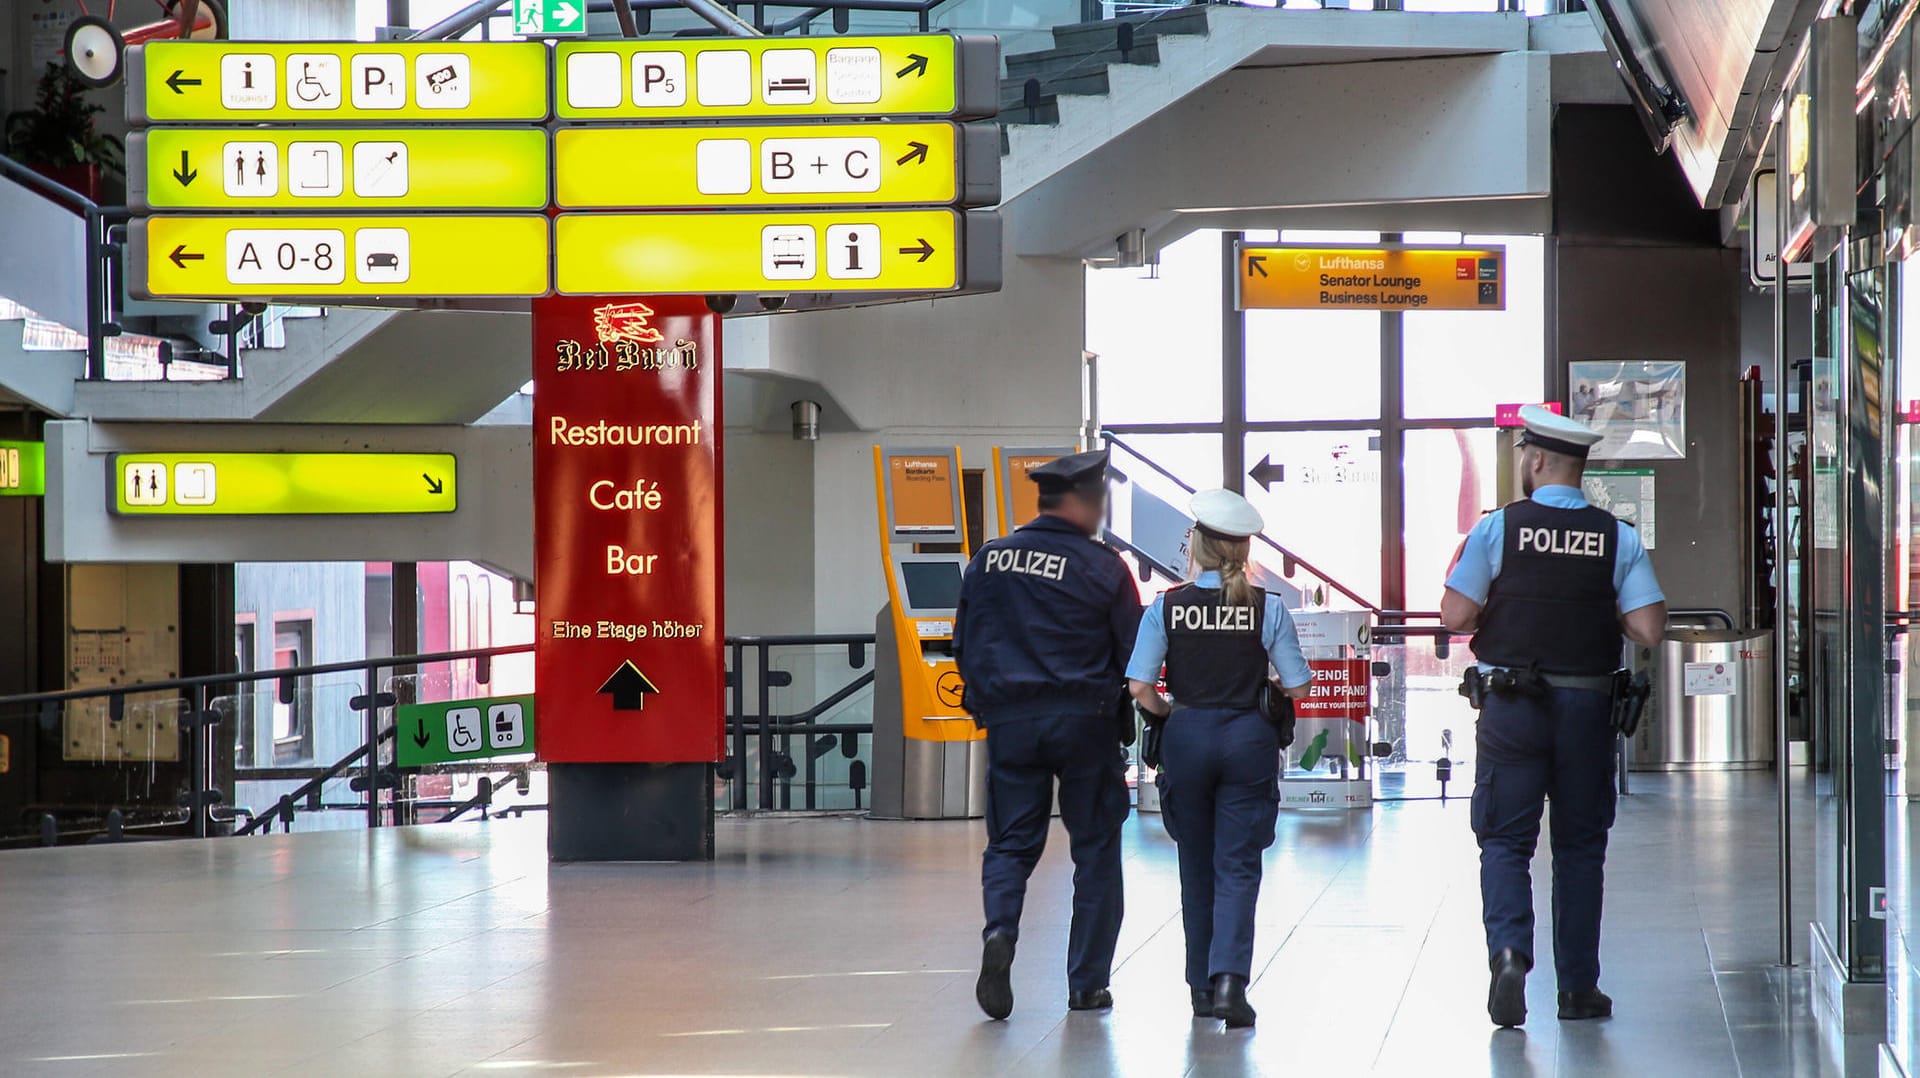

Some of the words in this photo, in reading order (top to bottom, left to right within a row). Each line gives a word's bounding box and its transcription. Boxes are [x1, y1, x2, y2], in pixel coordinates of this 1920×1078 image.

[771, 151, 794, 180] B
[810, 156, 829, 175] +
[843, 150, 870, 179] C
[237, 242, 262, 271] A
[277, 242, 333, 271] 0-8
[1319, 255, 1385, 270] Lufthansa
[1319, 274, 1370, 288] Senator
[1373, 274, 1421, 289] Lounge
[1319, 291, 1378, 305] Business
[1380, 292, 1428, 307] Lounge
[556, 339, 609, 372] Red
[551, 416, 701, 446] Restaurant
[589, 479, 662, 510] Café
[1518, 527, 1605, 557] POLIZEI
[606, 546, 658, 575] Bar
[985, 548, 1067, 581] POLIZEI
[552, 621, 592, 639] Eine
[597, 621, 648, 642] Etage
[652, 620, 703, 639] höher
[1171, 605, 1255, 631] POLIZEI
[1310, 669, 1349, 681] PENDE
[1309, 685, 1330, 697] EIN
